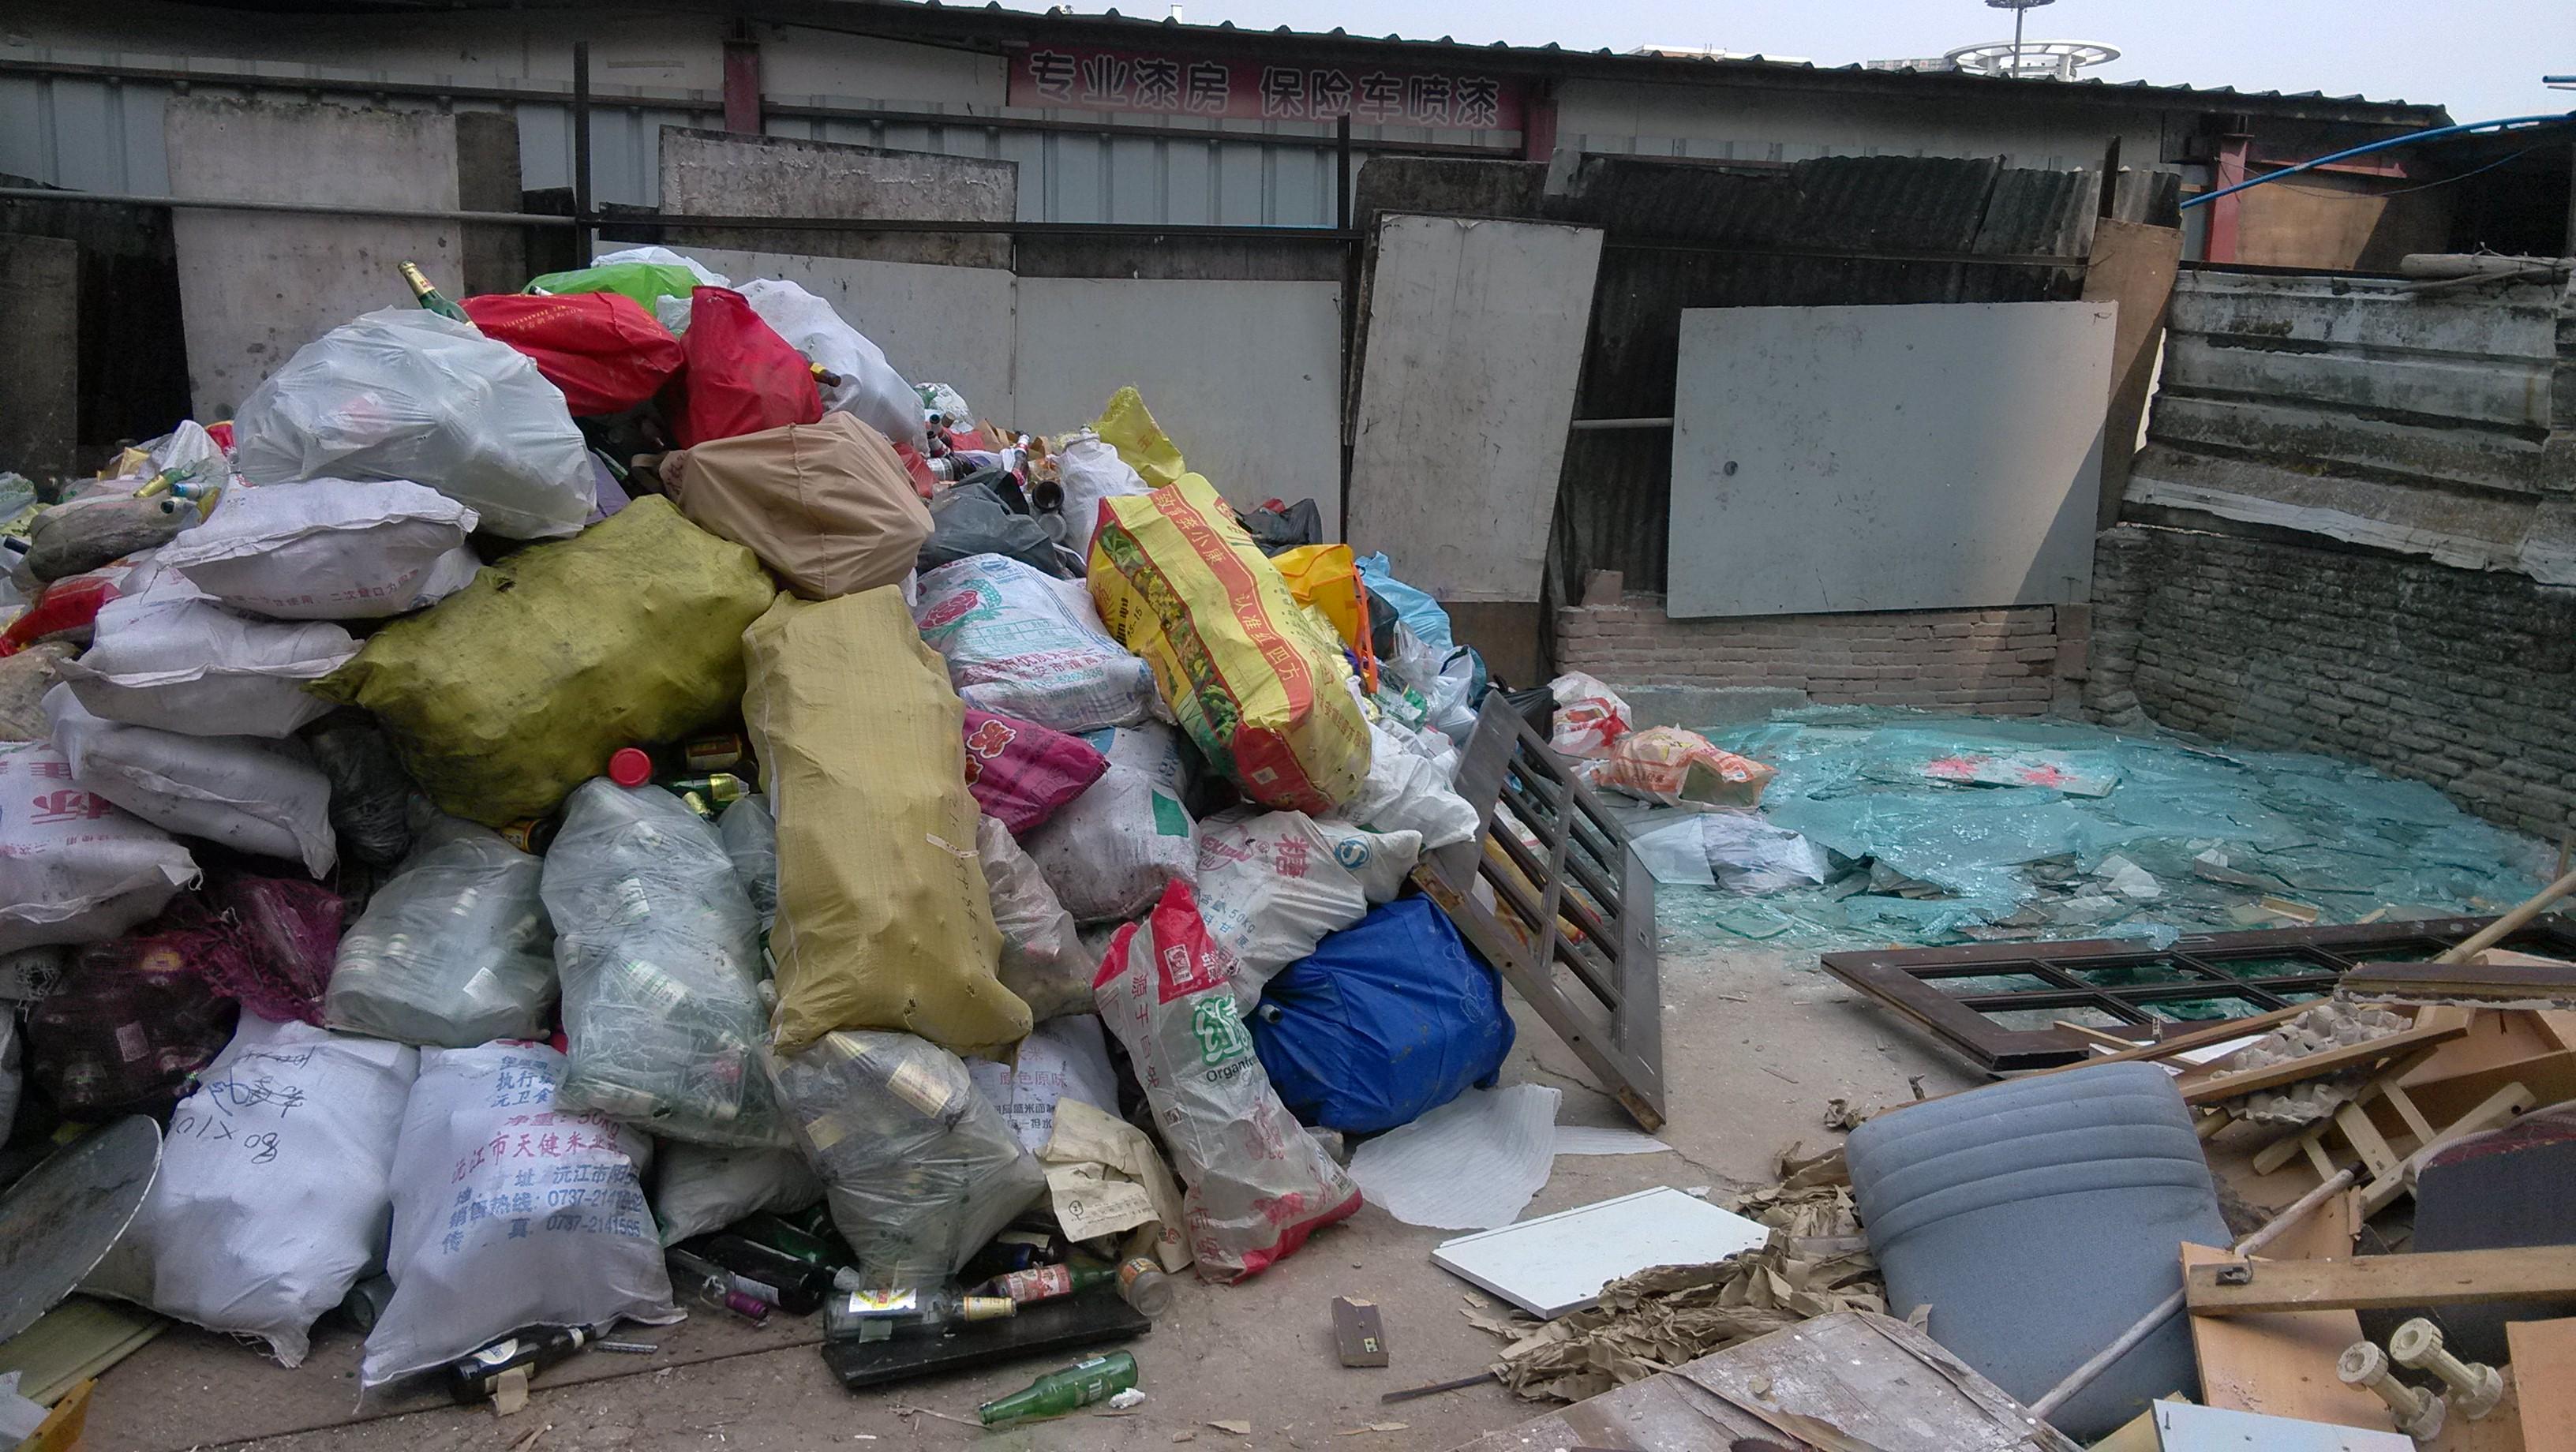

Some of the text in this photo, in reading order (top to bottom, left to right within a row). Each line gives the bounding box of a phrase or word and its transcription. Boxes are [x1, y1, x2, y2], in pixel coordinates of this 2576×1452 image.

[1029, 49, 1502, 127] 专业漆房 保险车喷漆
[1275, 833, 1310, 878] 糖
[1228, 908, 1256, 934] 50kg
